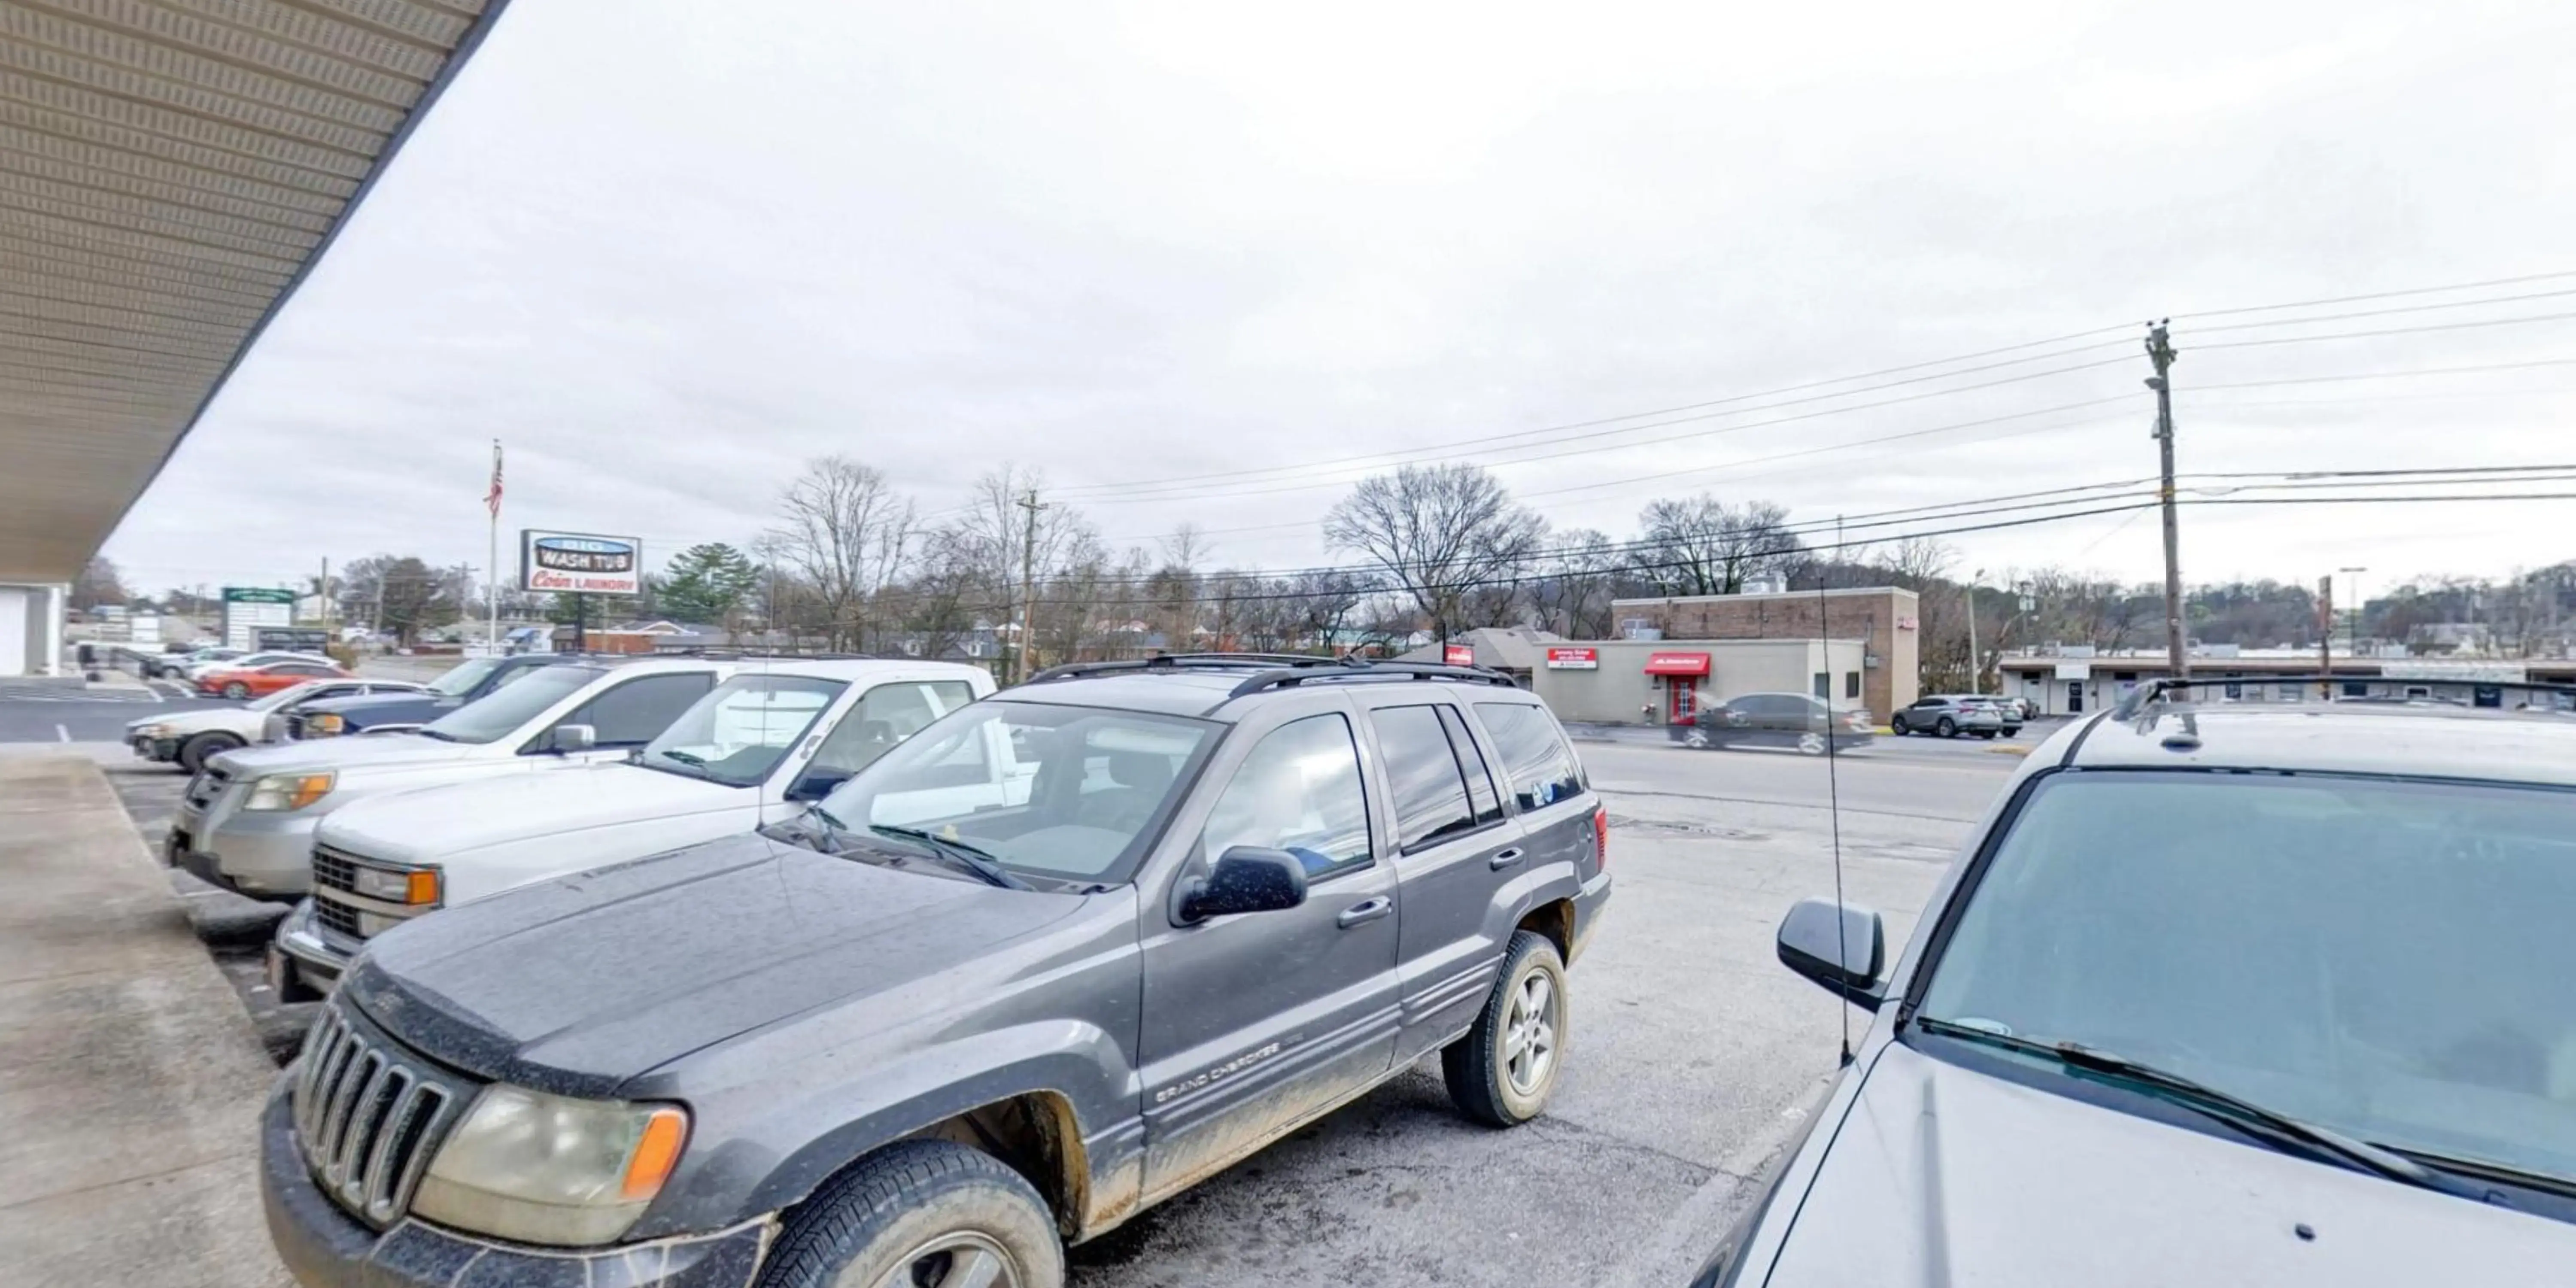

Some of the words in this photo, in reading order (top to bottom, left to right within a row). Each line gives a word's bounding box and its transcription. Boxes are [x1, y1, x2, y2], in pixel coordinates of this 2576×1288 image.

[541, 550, 590, 568] WASH
[593, 555, 627, 569] TUB
[575, 578, 634, 590] LAUNDRY
[1156, 1074, 1209, 1103] GRAND
[1210, 1042, 1280, 1080] CHEROKEE
